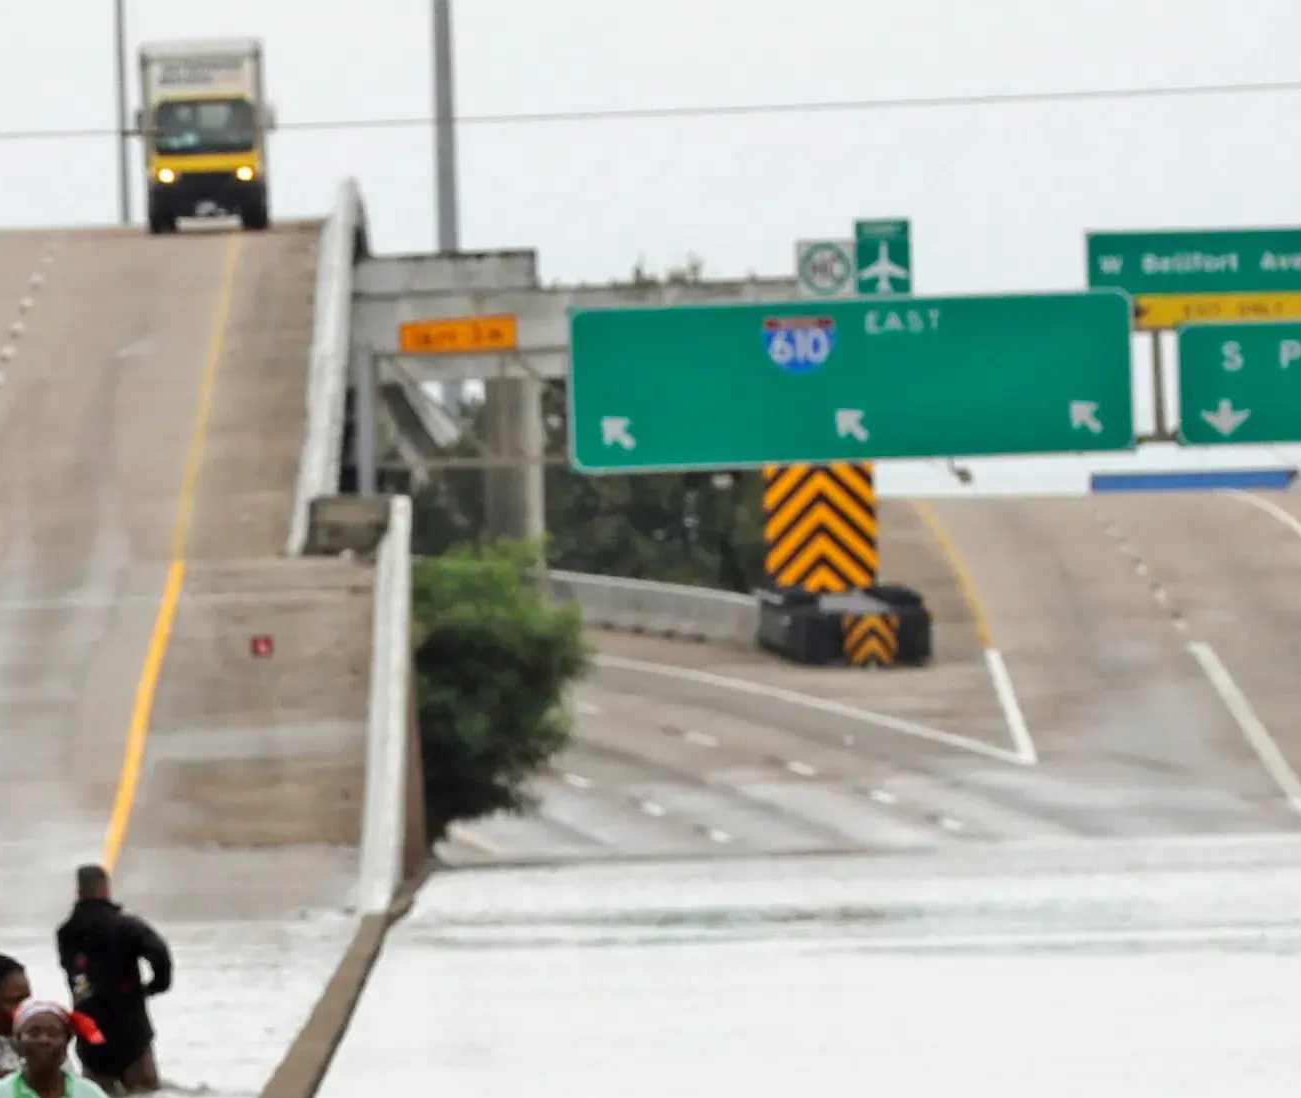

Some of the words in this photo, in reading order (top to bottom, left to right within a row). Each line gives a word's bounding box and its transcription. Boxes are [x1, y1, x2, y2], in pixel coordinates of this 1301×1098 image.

[1098, 253, 1124, 275] W
[1141, 251, 1240, 275] Bellfort
[864, 308, 940, 335] EAST
[768, 327, 831, 365] 610
[1221, 339, 1245, 372] S
